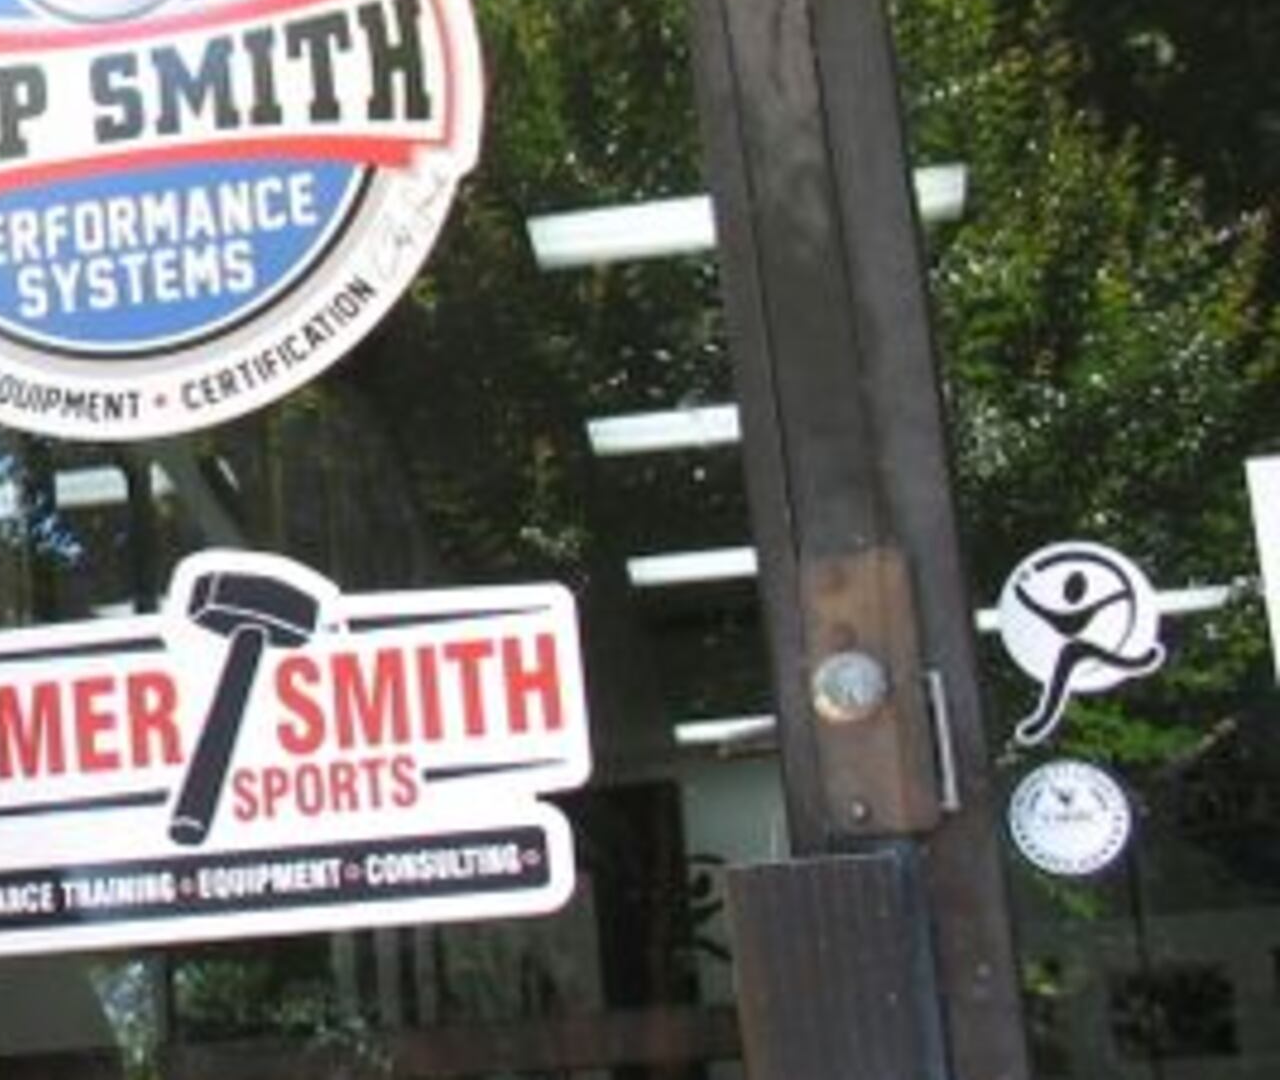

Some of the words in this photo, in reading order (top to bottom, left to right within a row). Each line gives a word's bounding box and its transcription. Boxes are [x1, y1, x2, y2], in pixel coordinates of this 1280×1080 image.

[16, 239, 256, 319] SYSTEMS
[181, 275, 377, 410] CERTIFICATION
[274, 630, 563, 757] SMITH
[231, 755, 419, 823] SPORTS
[60, 872, 176, 909] TRAINING
[198, 858, 342, 899] EQUIPMENT
[364, 842, 522, 885] CONSULTING
